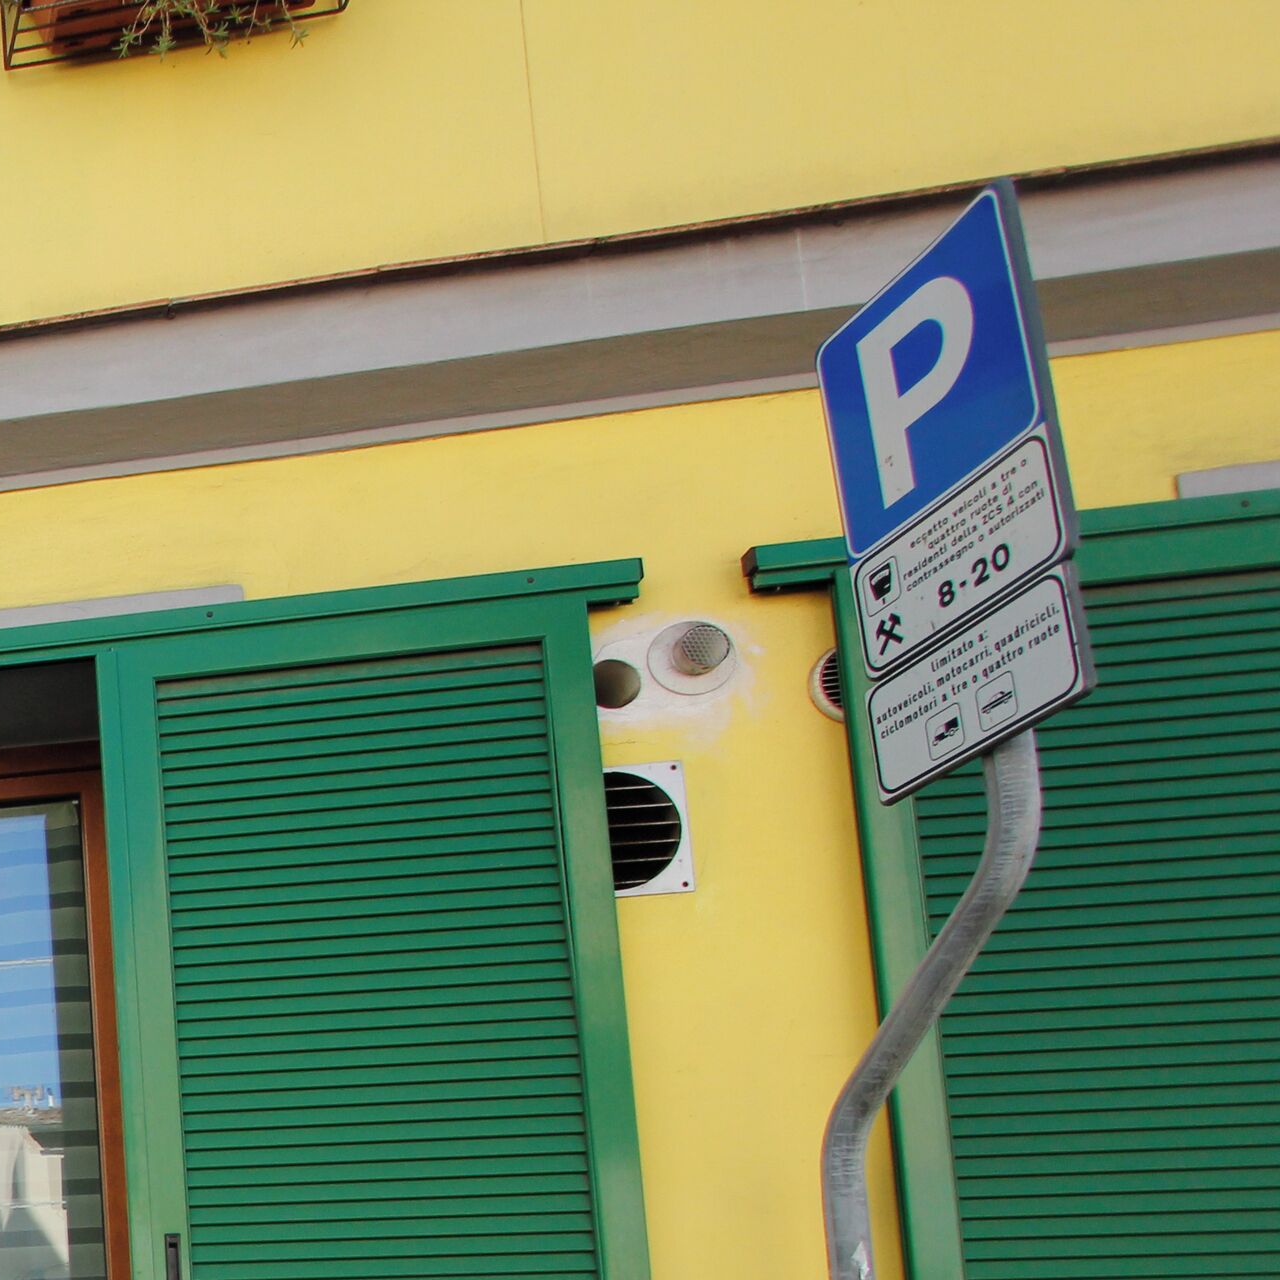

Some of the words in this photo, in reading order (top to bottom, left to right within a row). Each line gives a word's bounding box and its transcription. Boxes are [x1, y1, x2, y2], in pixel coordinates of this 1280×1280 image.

[856, 275, 973, 510] P
[903, 543, 947, 580] residenti
[951, 525, 978, 547] della
[981, 504, 1003, 526] ZCS
[1018, 480, 1038, 499] con
[906, 541, 974, 592] contrassegno
[987, 489, 1045, 536] autorizzati
[910, 517, 948, 548] eccetto
[952, 486, 986, 517] veicoli
[1000, 466, 1017, 482] tre
[927, 518, 966, 550] quattro
[970, 495, 998, 519] ruote
[1002, 482, 1012, 496] di
[880, 696, 938, 740] ciclomotori
[951, 680, 968, 696] tre
[981, 645, 1024, 680] quattro
[1028, 623, 1061, 650] ruote
[930, 640, 974, 673] limitato
[977, 629, 989, 643] a:
